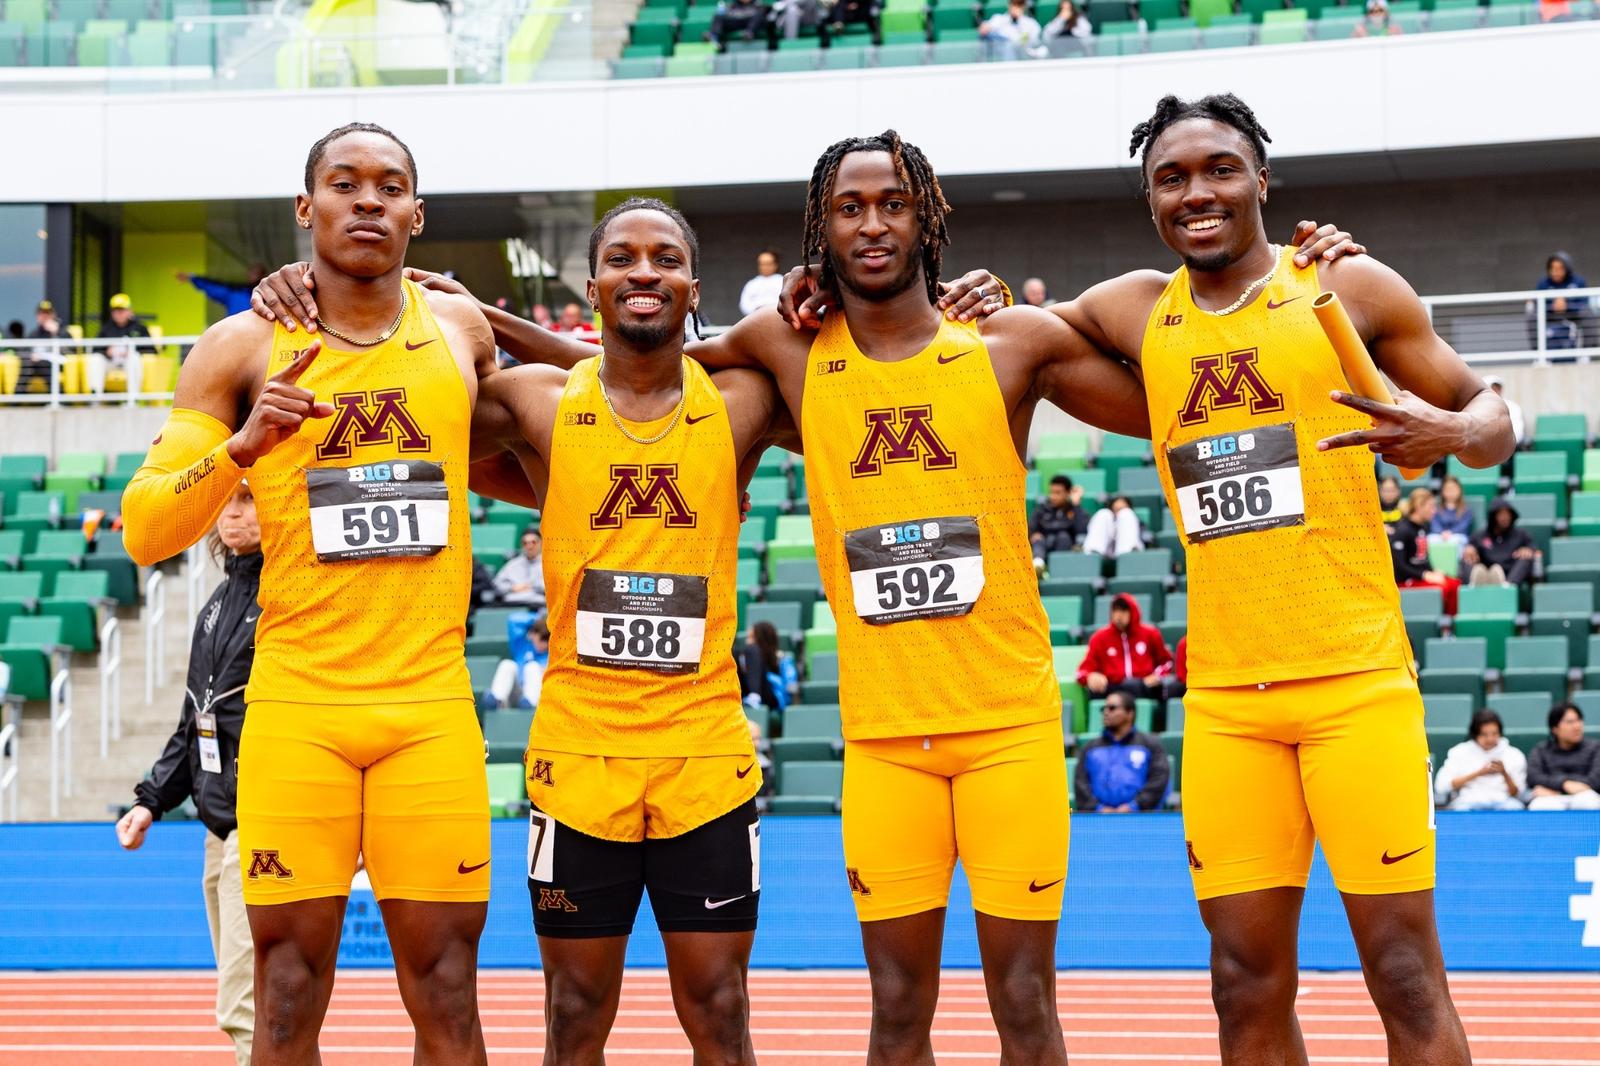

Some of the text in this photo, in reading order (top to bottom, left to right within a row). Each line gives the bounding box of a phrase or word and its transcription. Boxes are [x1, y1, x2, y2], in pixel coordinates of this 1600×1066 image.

[1178, 347, 1284, 428] M
[316, 388, 430, 461] M
[850, 404, 957, 478] M
[1206, 458, 1230, 466] OUTDOOR
[1209, 465, 1247, 476] CHAMPIONSHIPS
[590, 463, 697, 530] M
[1196, 476, 1272, 526] 586
[343, 504, 420, 546] 591
[893, 553, 932, 562] CHAMPIONSHIPS
[876, 564, 958, 610] 592
[601, 618, 680, 659] 588
[248, 850, 292, 878] M
[531, 815, 546, 874] 7
